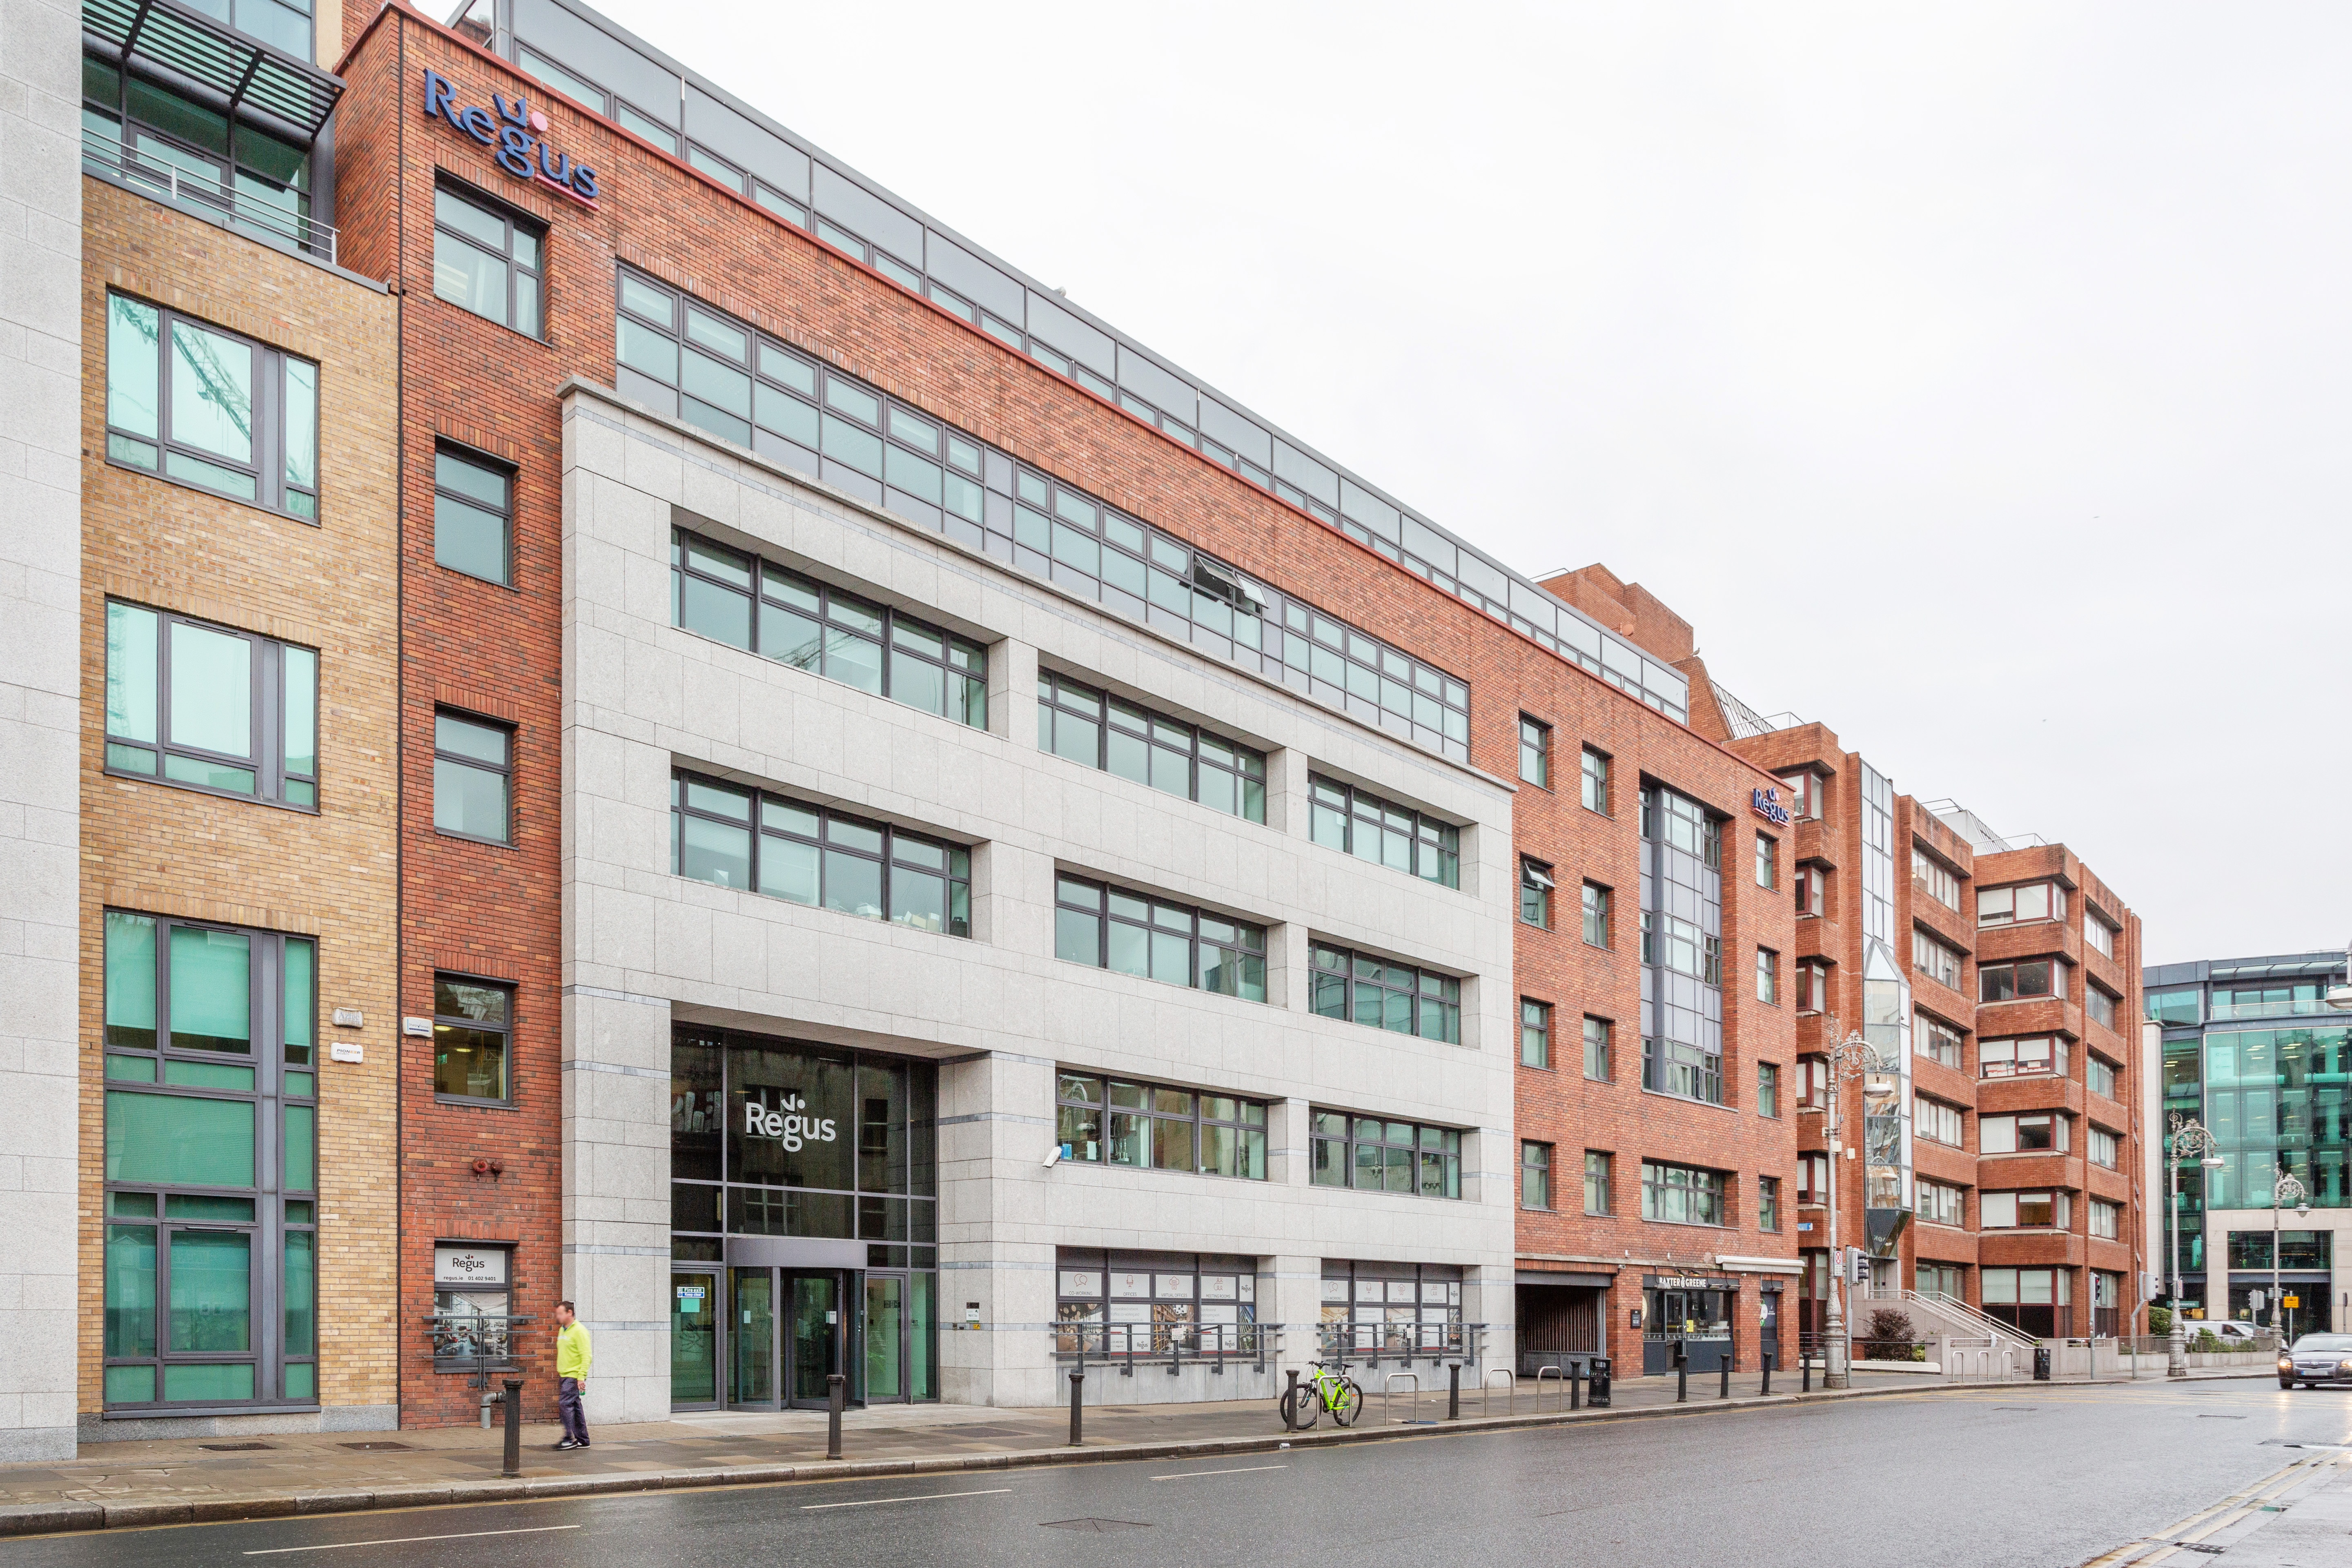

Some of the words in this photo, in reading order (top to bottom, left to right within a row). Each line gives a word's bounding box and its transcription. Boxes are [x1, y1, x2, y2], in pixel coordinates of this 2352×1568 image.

[423, 68, 599, 198] Regus
[1752, 788, 1790, 822] Regus
[746, 1102, 836, 1152] Regus
[452, 1258, 485, 1272] Regus
[1685, 1278, 1706, 1287] GREENE
